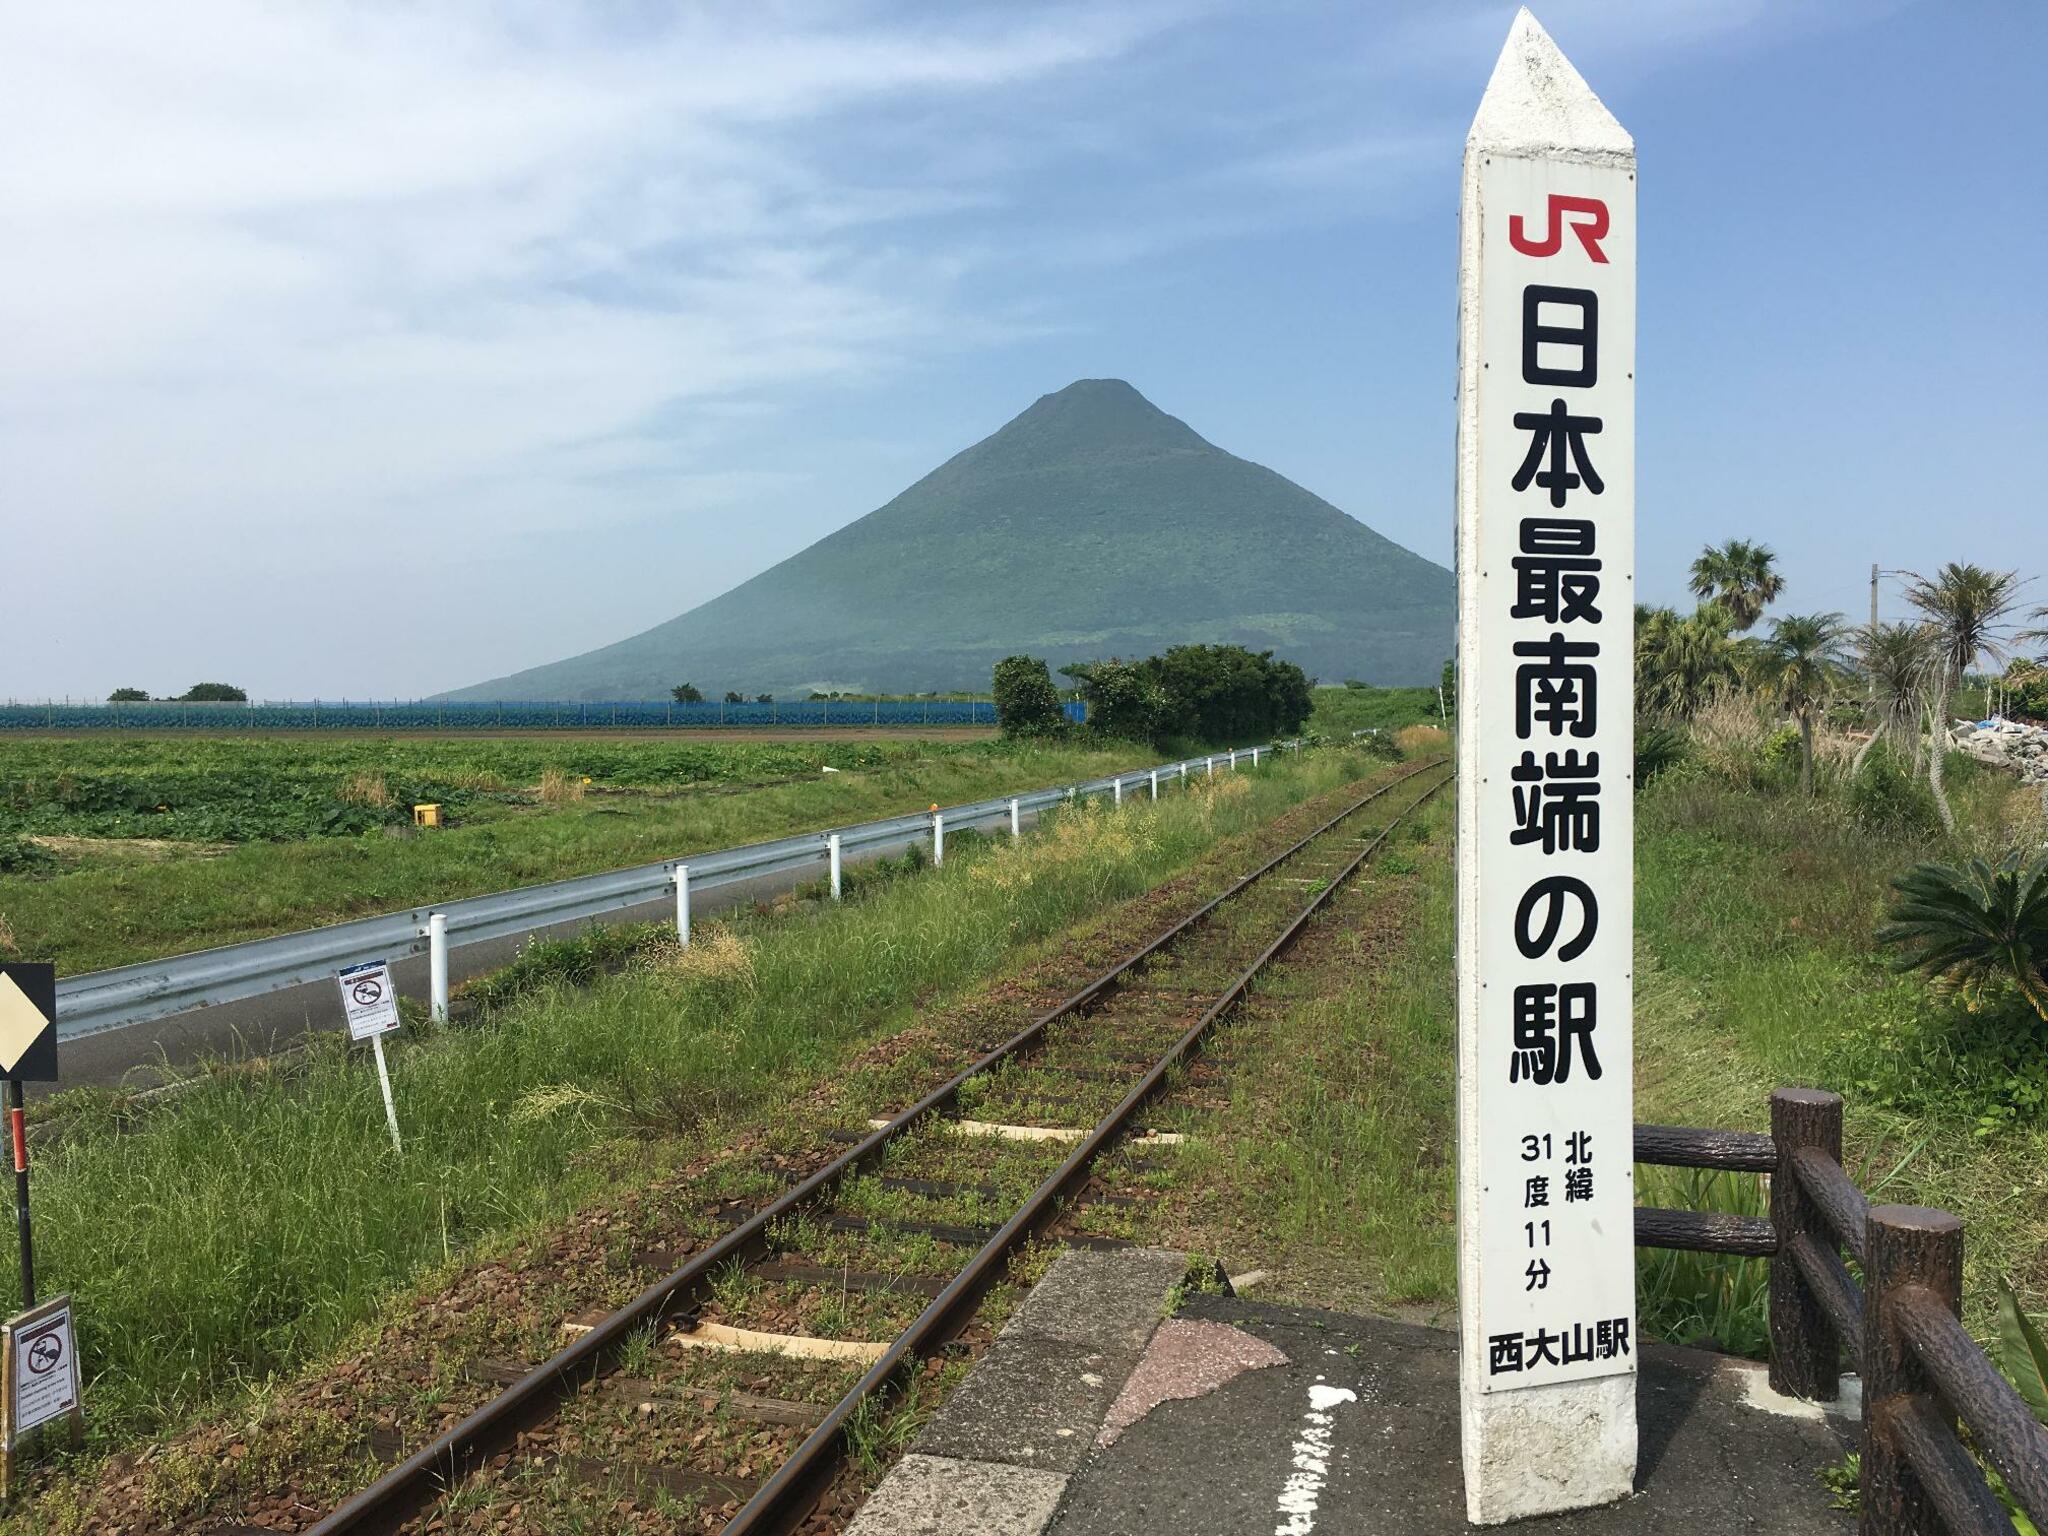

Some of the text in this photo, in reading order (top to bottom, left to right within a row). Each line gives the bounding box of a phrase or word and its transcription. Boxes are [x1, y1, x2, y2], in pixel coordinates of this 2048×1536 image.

[1509, 195, 1610, 264] JR
[1510, 284, 1605, 1086] 日本最南端の駅
[1564, 1130, 1594, 1204] 北緯
[1488, 1317, 1630, 1376] 西大山駅
